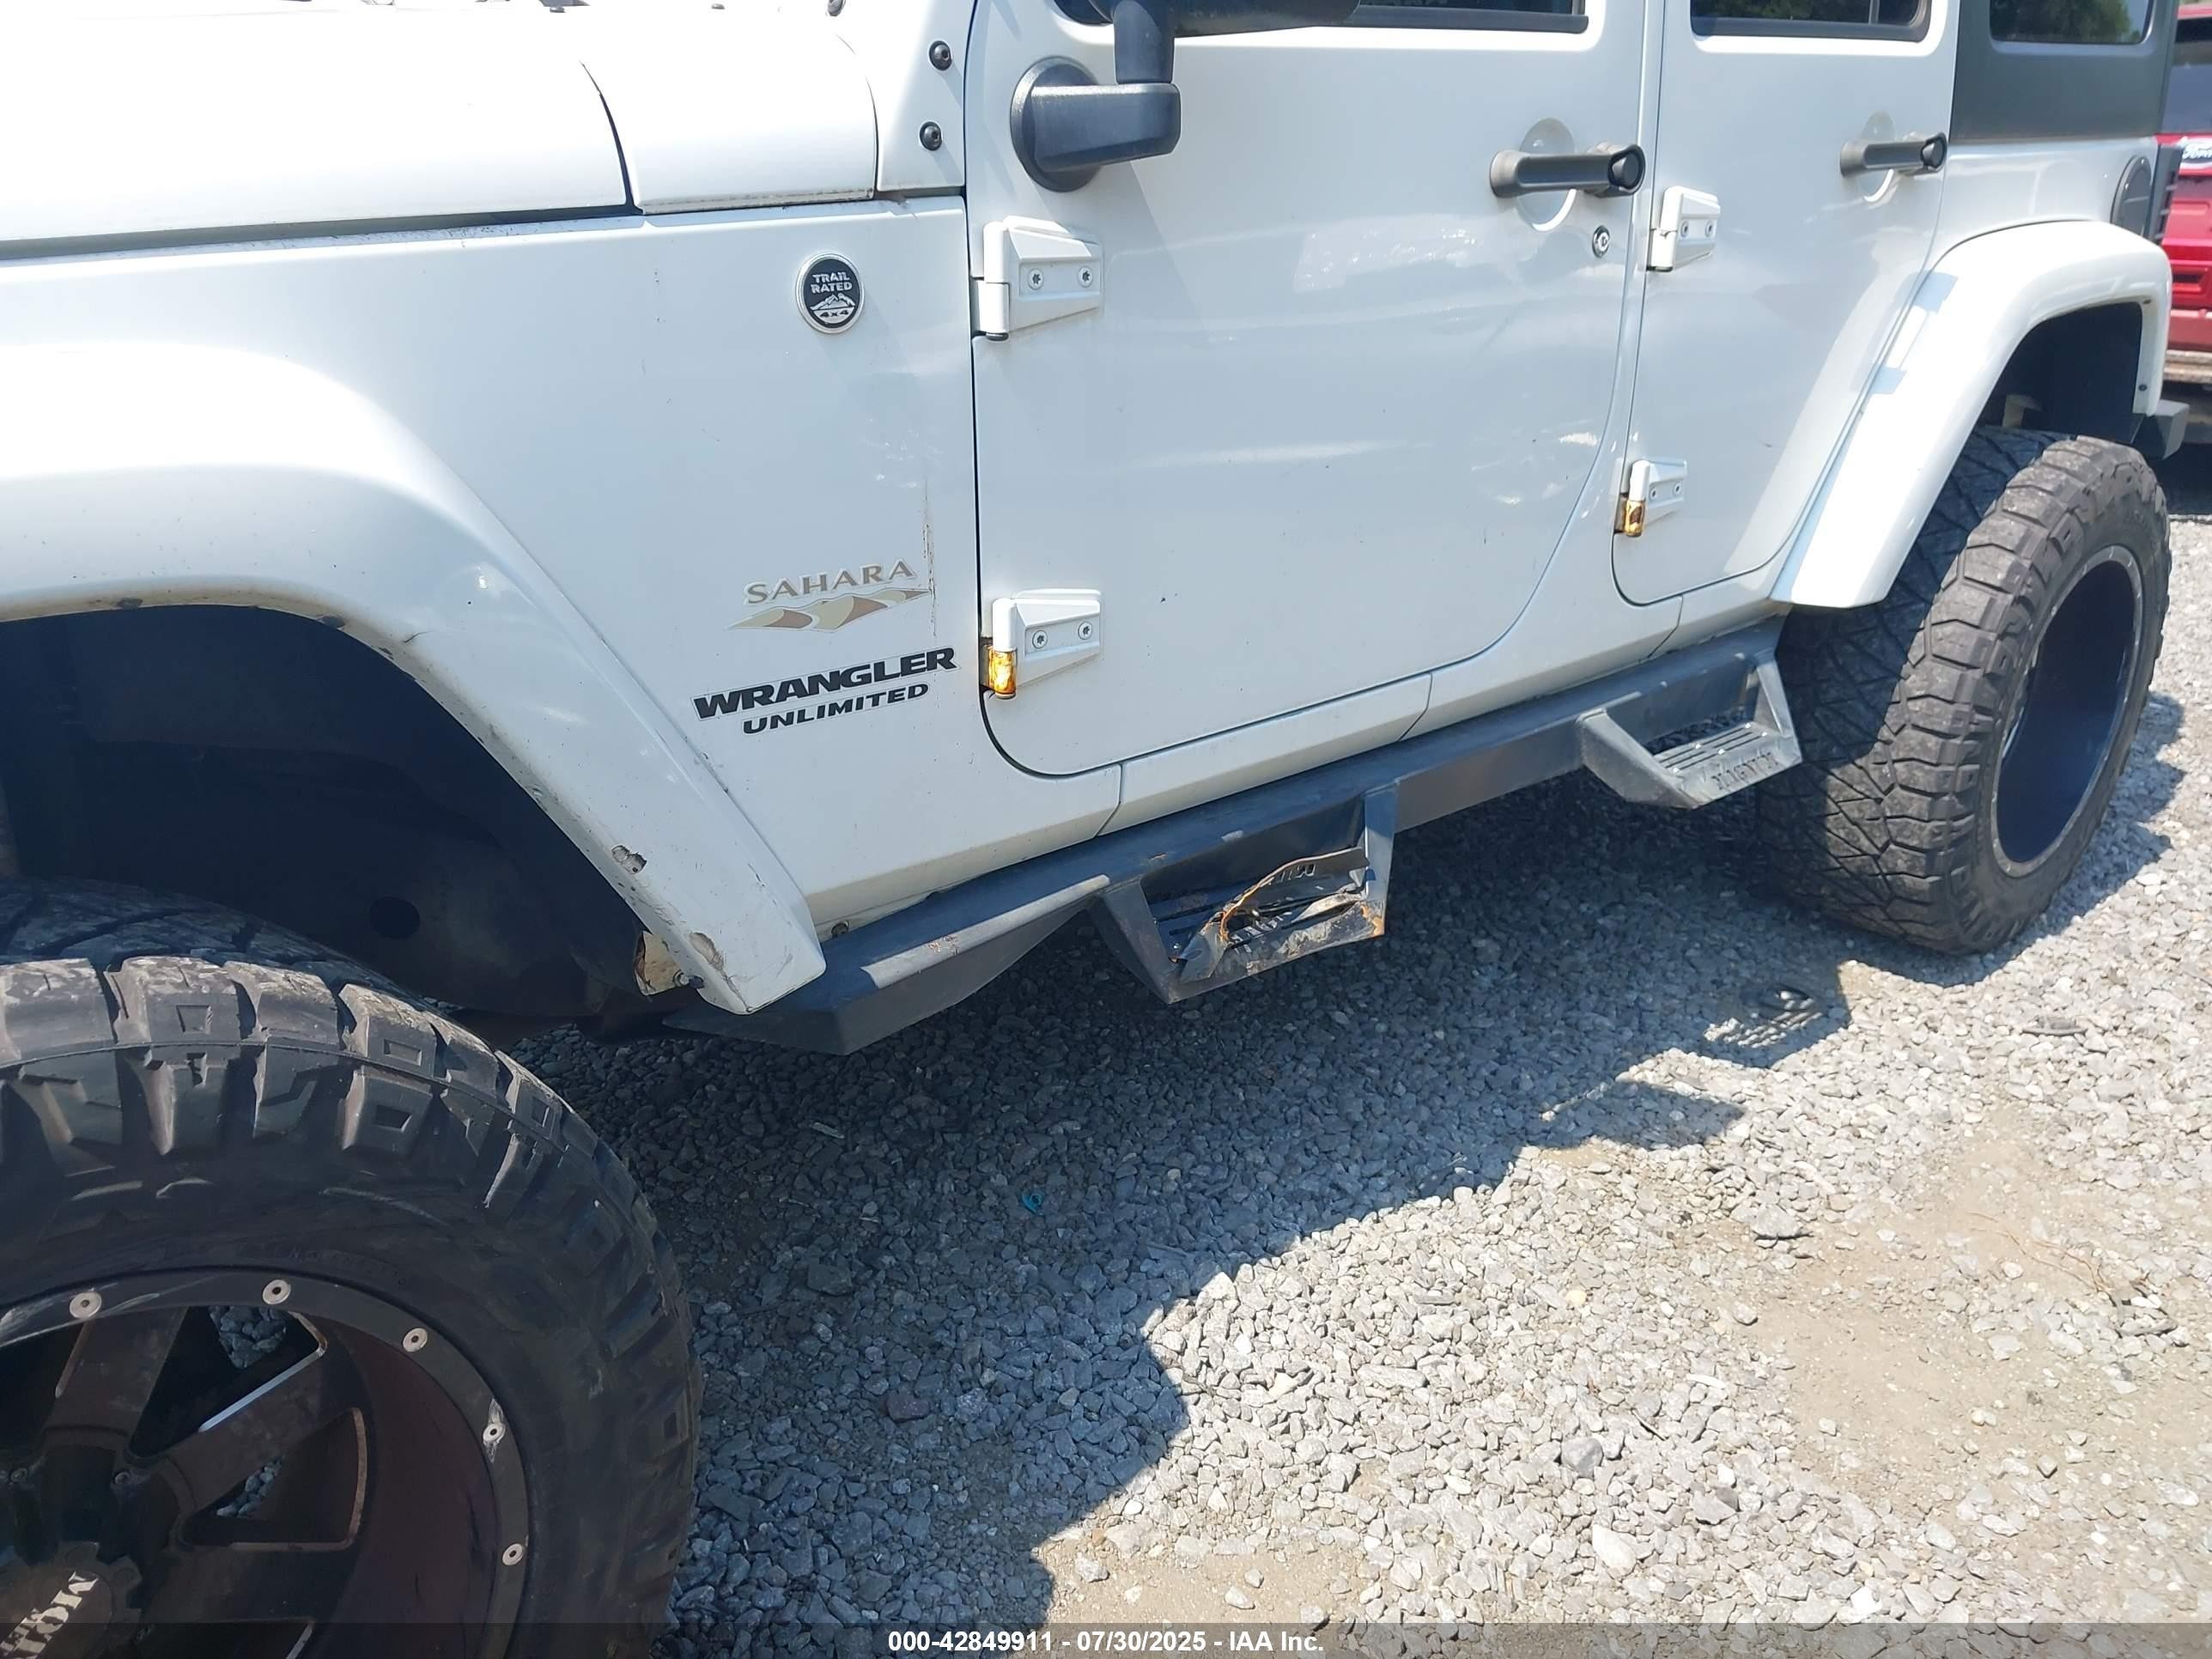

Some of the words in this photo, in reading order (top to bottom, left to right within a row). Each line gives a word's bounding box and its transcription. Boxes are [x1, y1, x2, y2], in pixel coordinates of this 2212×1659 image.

[811, 282, 853, 294] RATED
[812, 271, 850, 283] TRAIL
[745, 560, 915, 605] SAHARA
[693, 647, 958, 720] WRANGLER
[742, 683, 930, 735] UNLIMITED
